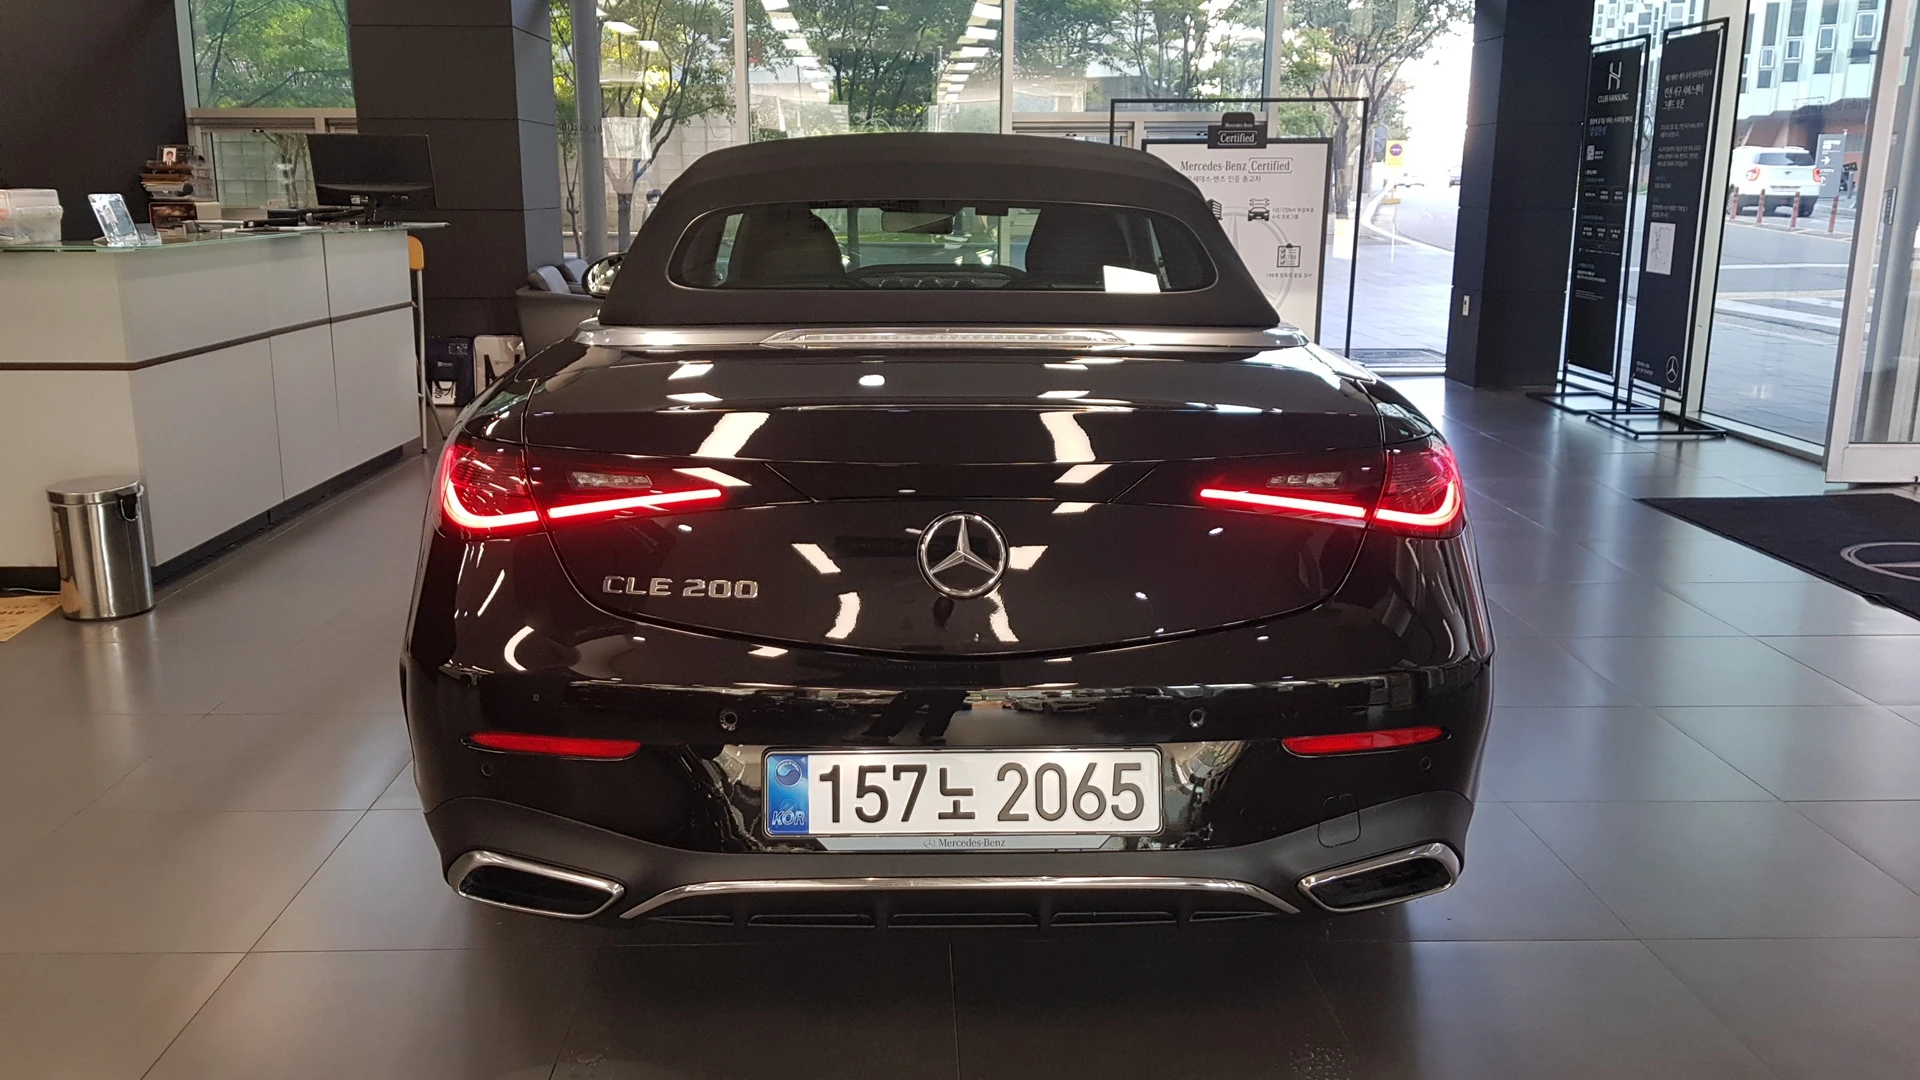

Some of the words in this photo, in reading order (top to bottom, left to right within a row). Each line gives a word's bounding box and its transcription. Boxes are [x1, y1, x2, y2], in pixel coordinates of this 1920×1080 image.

[1598, 95, 1608, 103] CLUB
[1609, 93, 1629, 102] HANSUNG
[1220, 133, 1255, 143] Certified
[1180, 160, 1247, 171] Mercedes-Benz
[1251, 160, 1290, 171] Certified
[1190, 175, 1226, 183] 세데스-벤츠
[602, 575, 673, 596] CLE
[682, 578, 759, 599] 200
[819, 763, 976, 824] 157노
[996, 762, 1145, 824] 2065
[772, 811, 805, 825] KOR
[938, 838, 1006, 848] Mercedes-Benz
